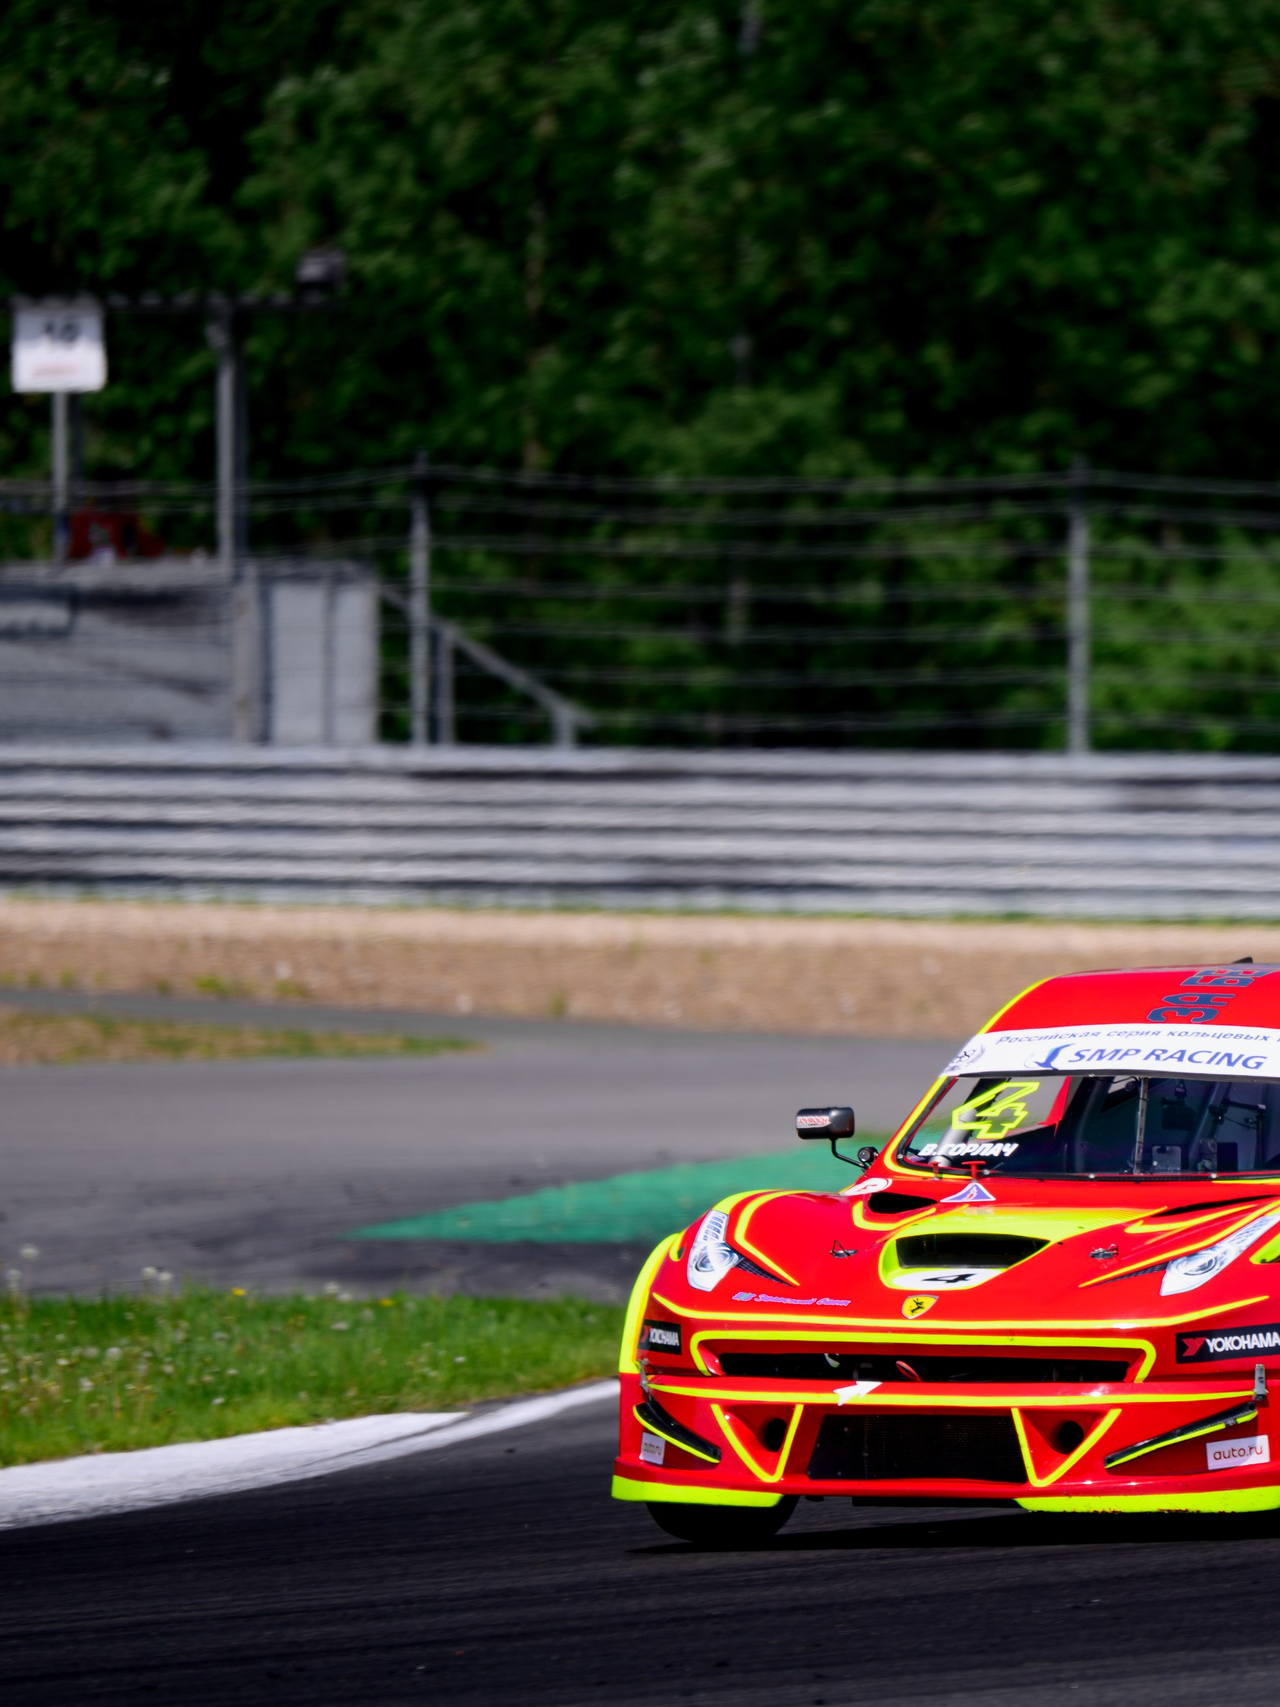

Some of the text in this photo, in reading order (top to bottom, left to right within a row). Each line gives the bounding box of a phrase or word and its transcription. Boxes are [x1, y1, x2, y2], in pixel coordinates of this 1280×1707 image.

[996, 1032, 1101, 1044] Российская
[1106, 1030, 1162, 1040] серия
[1167, 1030, 1271, 1042] кольцевых
[1068, 1048, 1268, 1070] SMP RACING
[952, 1082, 1040, 1139] 4
[918, 1143, 1019, 1157] В.ГОРЛАЧ
[1213, 1445, 1262, 1460] auto.ru
